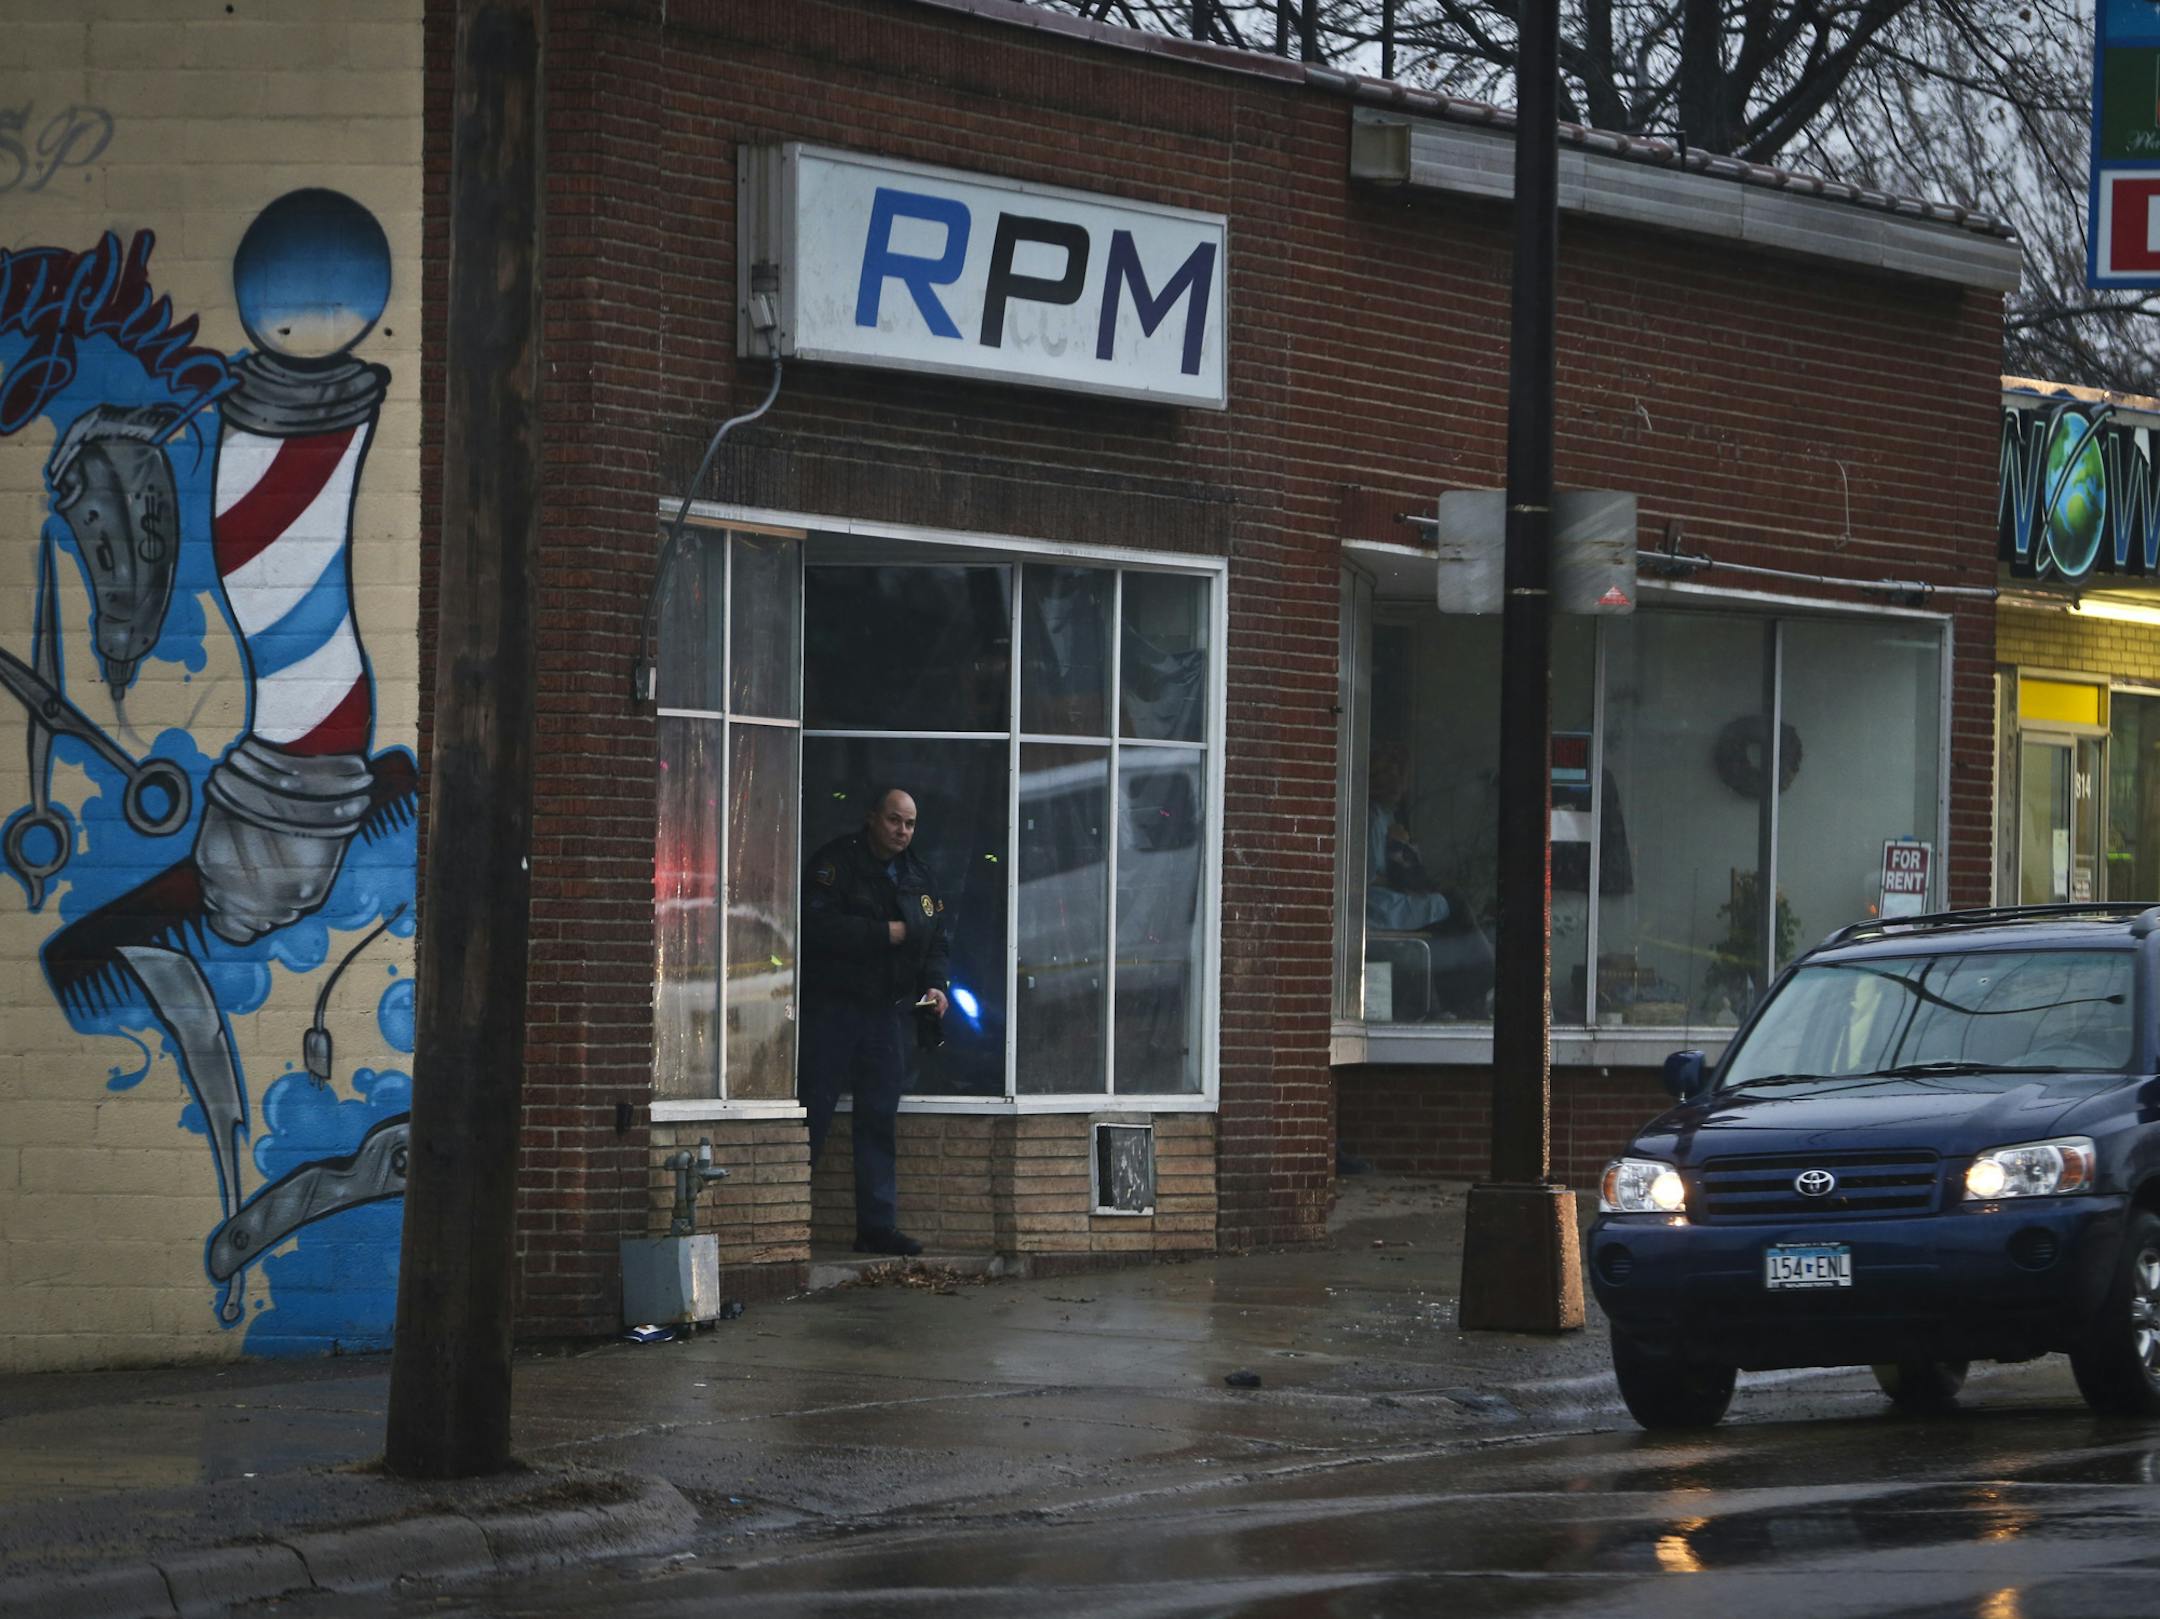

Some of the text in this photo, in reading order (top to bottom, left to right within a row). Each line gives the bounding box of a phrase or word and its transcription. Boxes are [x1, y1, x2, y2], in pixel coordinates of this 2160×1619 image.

[854, 186, 1218, 377] RPM
[1891, 848, 1921, 870] FOR
[1885, 871, 1925, 892] RENT
[1770, 1255, 1850, 1281] 154 ENL
